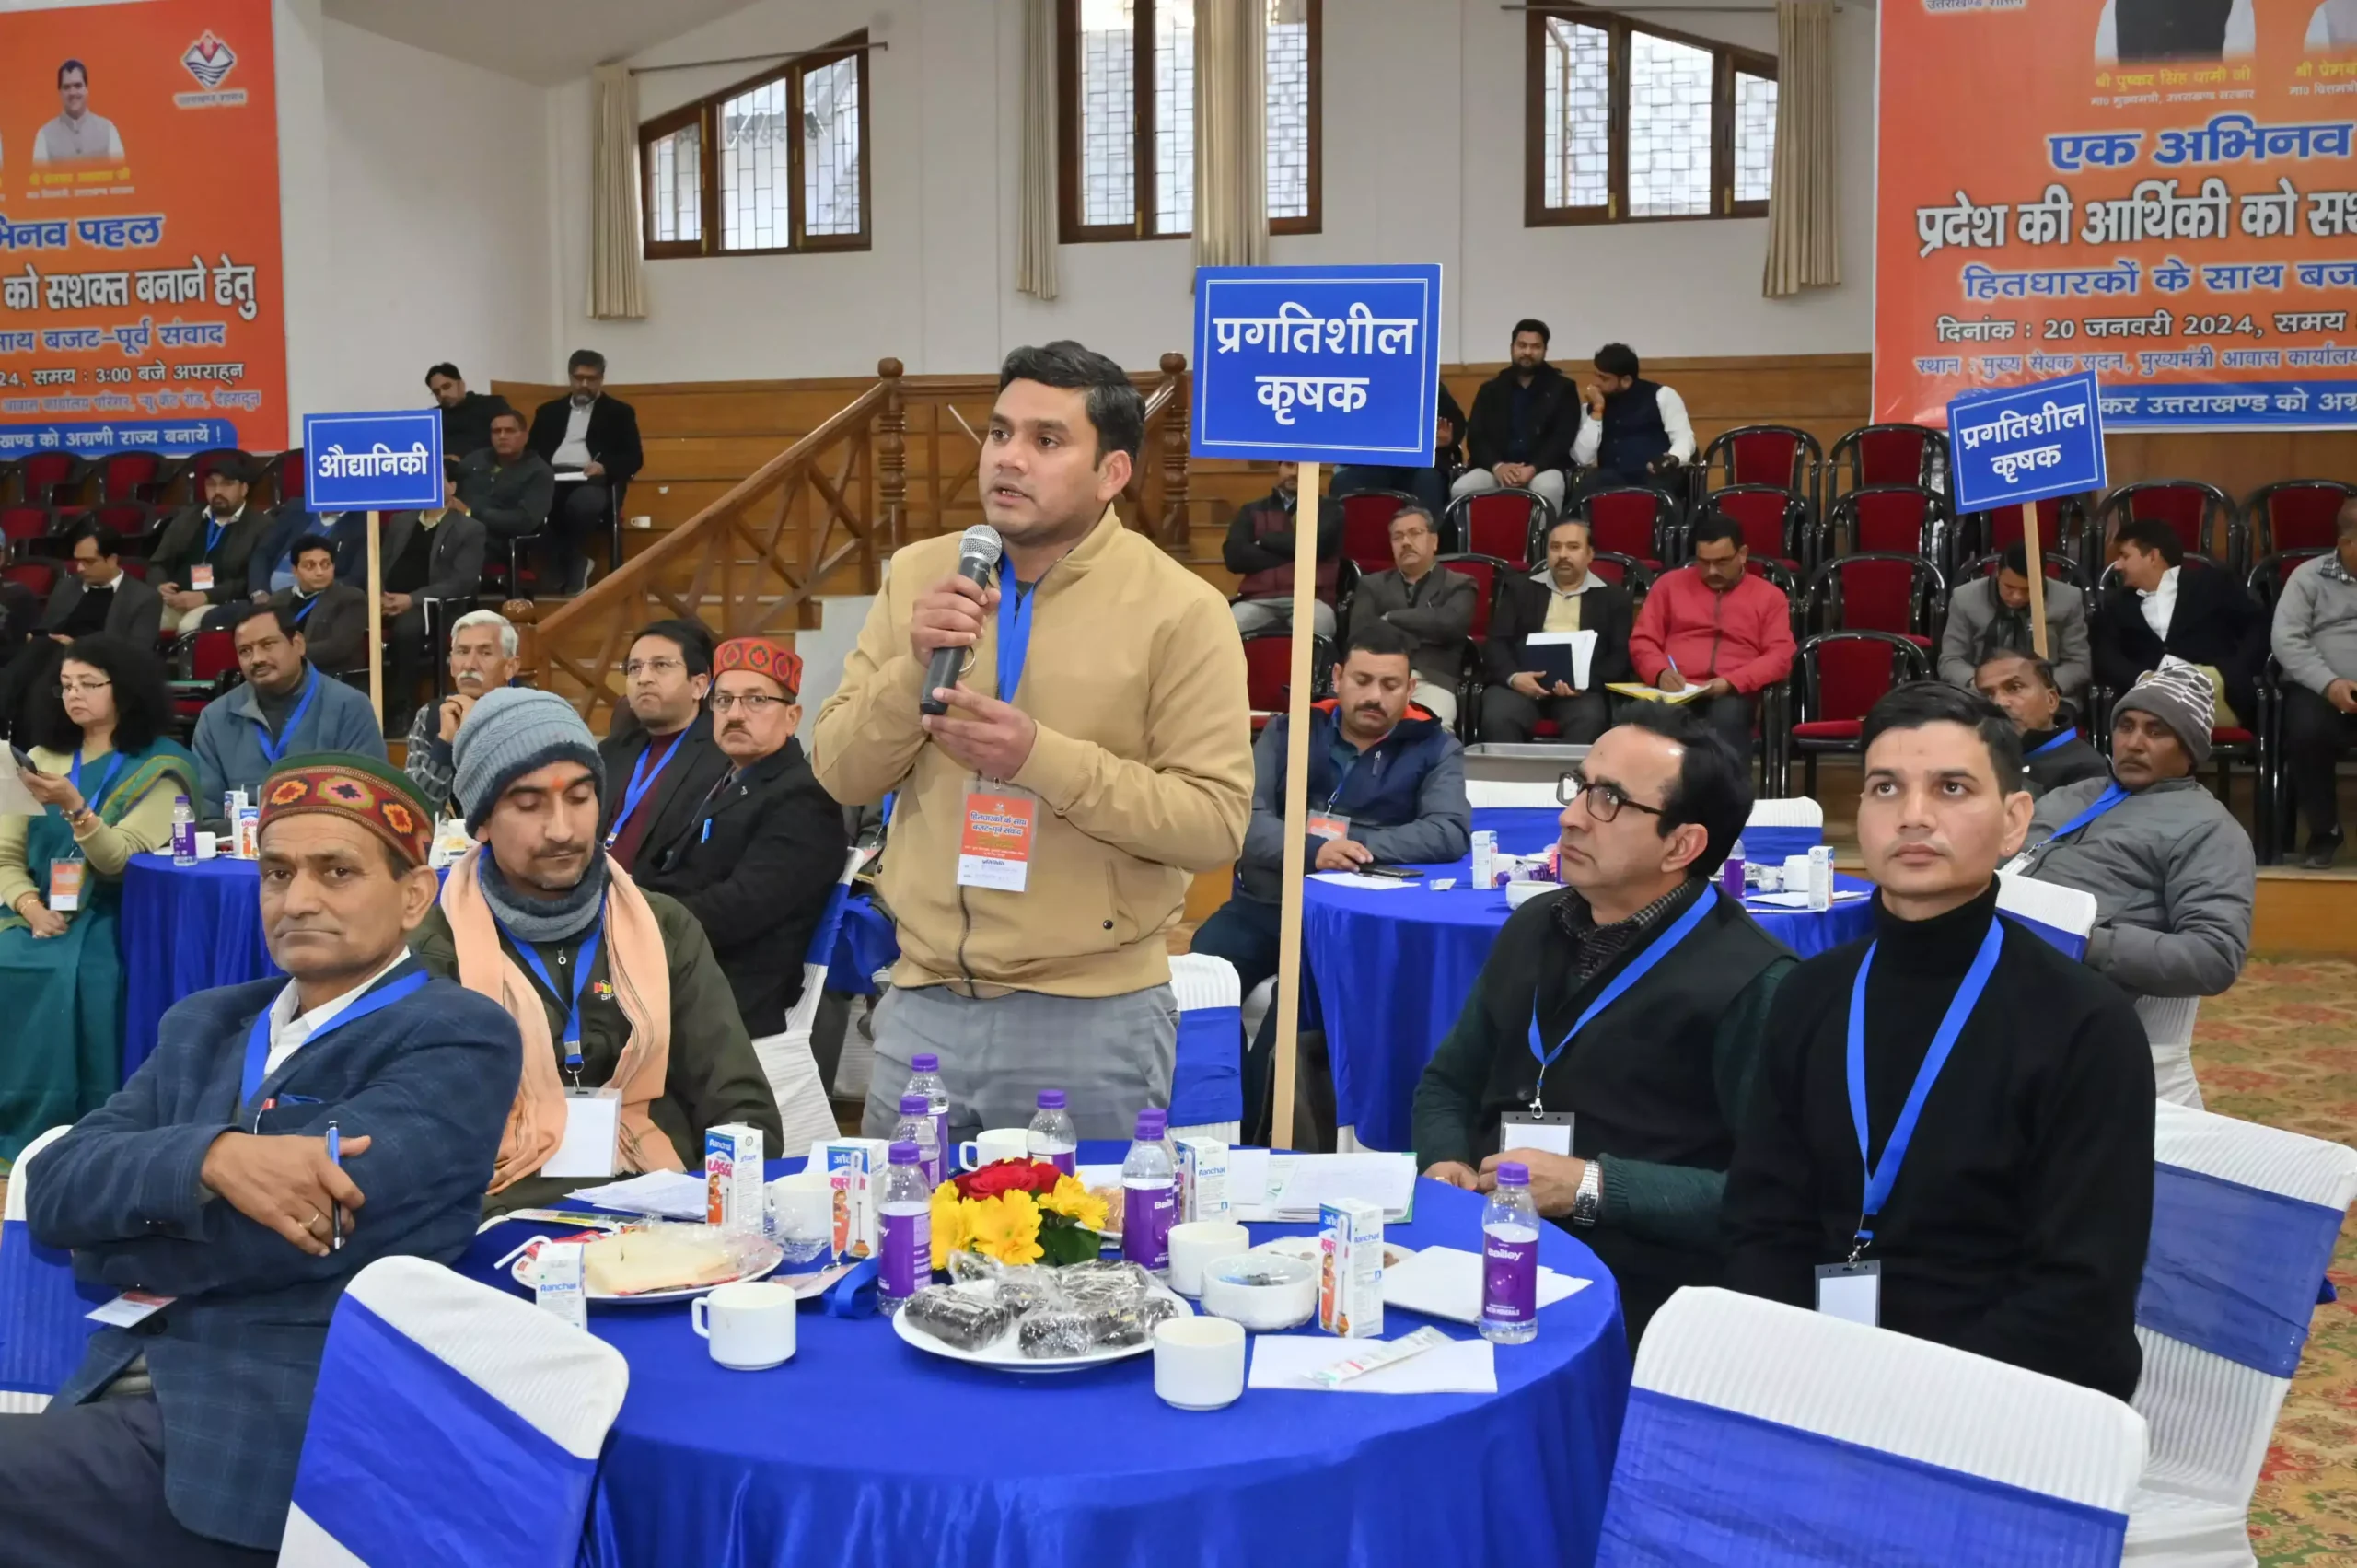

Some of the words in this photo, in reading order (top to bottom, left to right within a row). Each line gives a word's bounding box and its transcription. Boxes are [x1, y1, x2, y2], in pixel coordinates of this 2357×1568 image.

[2049, 134, 2142, 168] एक
[2153, 113, 2354, 164] अभिनव
[77, 216, 163, 248] पहल
[1916, 190, 2010, 259] प्रदेश
[2016, 183, 2073, 245] की
[2081, 177, 2232, 245] आर्थिकी
[2239, 176, 2299, 237] को
[3, 262, 39, 310] को
[45, 272, 129, 310] सशक्त
[134, 254, 206, 304] बनाने
[213, 254, 258, 320] हेतु
[1963, 260, 2140, 299] हितधारकों
[2154, 258, 2192, 292] के
[2203, 265, 2284, 291] साथ
[158, 319, 225, 344] संवाद
[1213, 300, 1419, 355] प्रगतिशील
[1937, 315, 2016, 343] दिनांक
[2026, 322, 2032, 339] :
[2043, 319, 2076, 340] 20
[2084, 309, 2174, 339] जनवरी
[2183, 314, 2265, 339] 2024,
[2273, 312, 2347, 333] समय
[32, 368, 76, 385] समय
[96, 367, 132, 384] 3:00
[137, 359, 167, 381] बजे
[1915, 356, 1961, 374] स्थान
[1981, 355, 2022, 380] मुख्य
[2029, 349, 2074, 371] सेवक
[2222, 350, 2280, 367] आवास
[1254, 375, 1370, 426] कृषक
[2147, 395, 2269, 414] उत्तराखण्ड
[2275, 386, 2310, 412] को
[39, 427, 60, 447] को
[65, 425, 114, 447] अग्रणी
[118, 430, 158, 445] राज्य
[1960, 401, 2086, 451] प्रगतिशील
[318, 441, 429, 479] औद्यानिकी
[1990, 443, 2062, 484] कृषक
